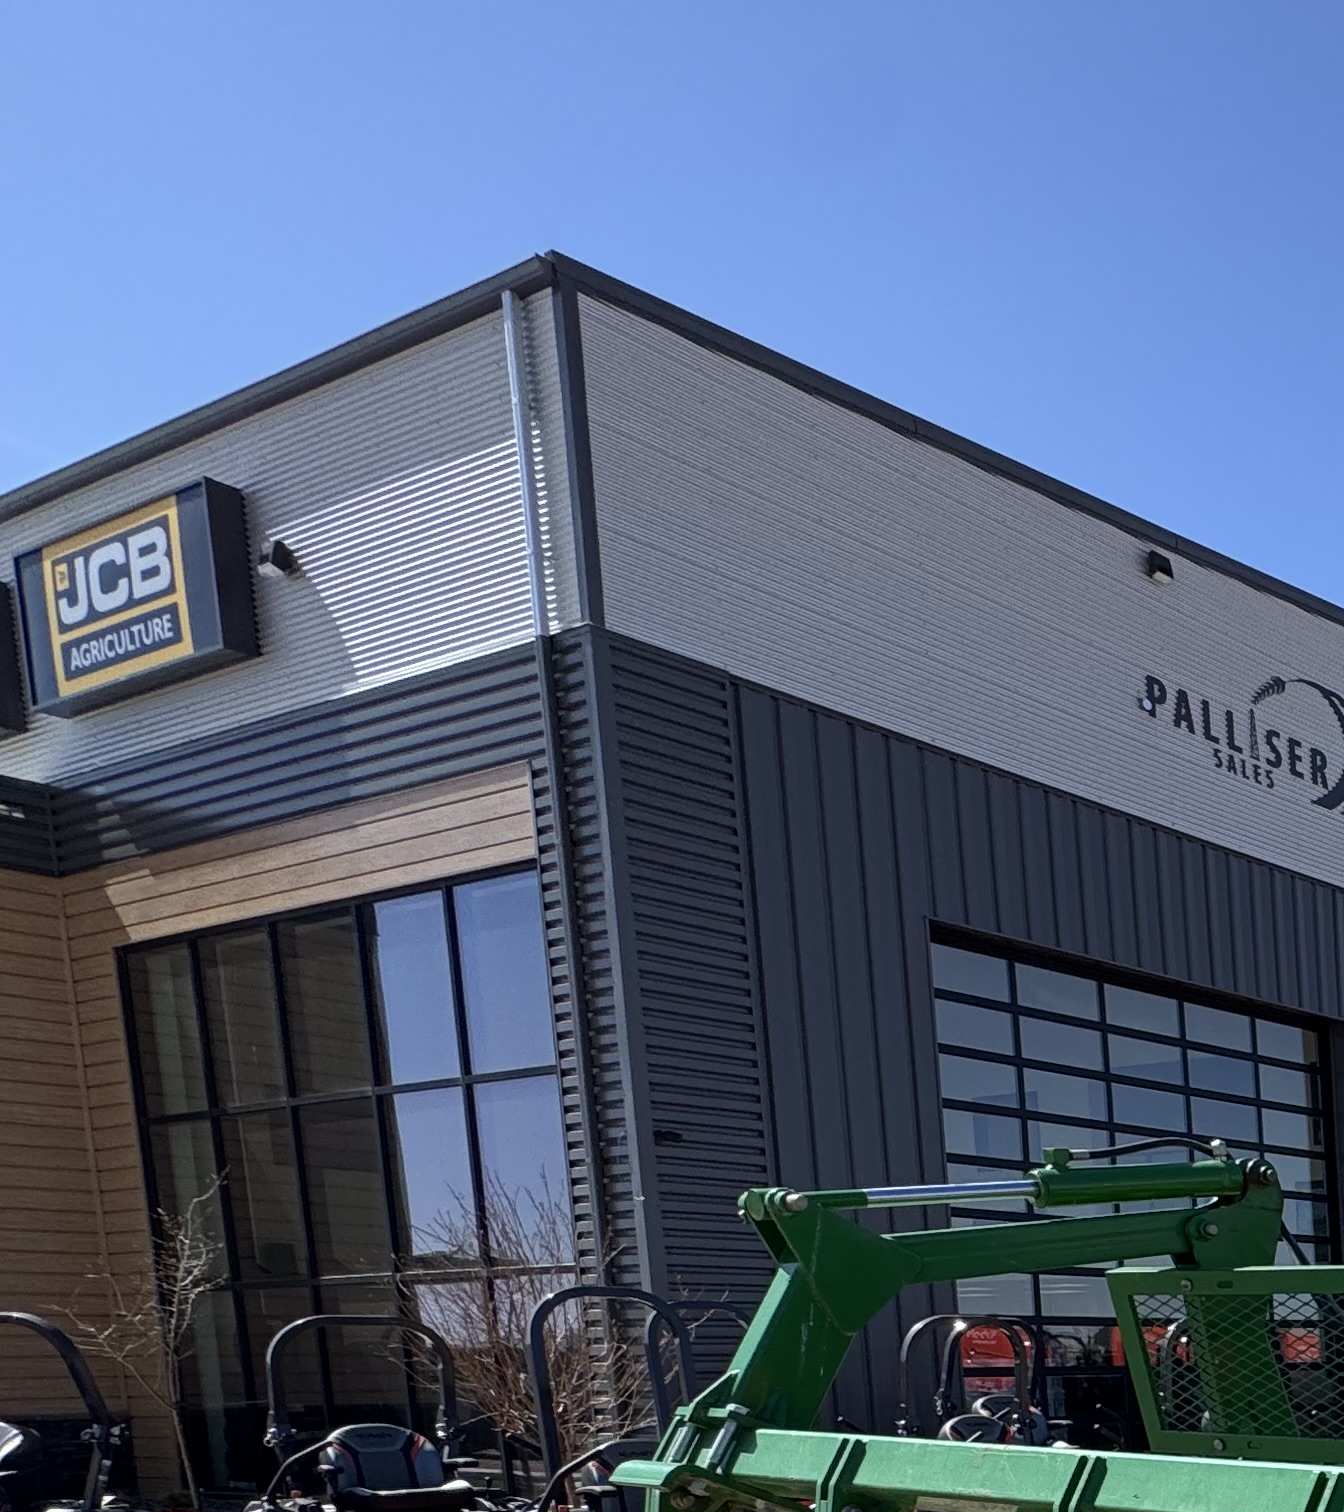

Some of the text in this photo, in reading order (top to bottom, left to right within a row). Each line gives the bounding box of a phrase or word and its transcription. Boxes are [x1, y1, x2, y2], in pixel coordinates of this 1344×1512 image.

[56, 526, 172, 625] JCB
[70, 613, 174, 671] AGRICULTURE
[1145, 674, 1329, 789] PALLISER
[1212, 748, 1275, 789] SALES
